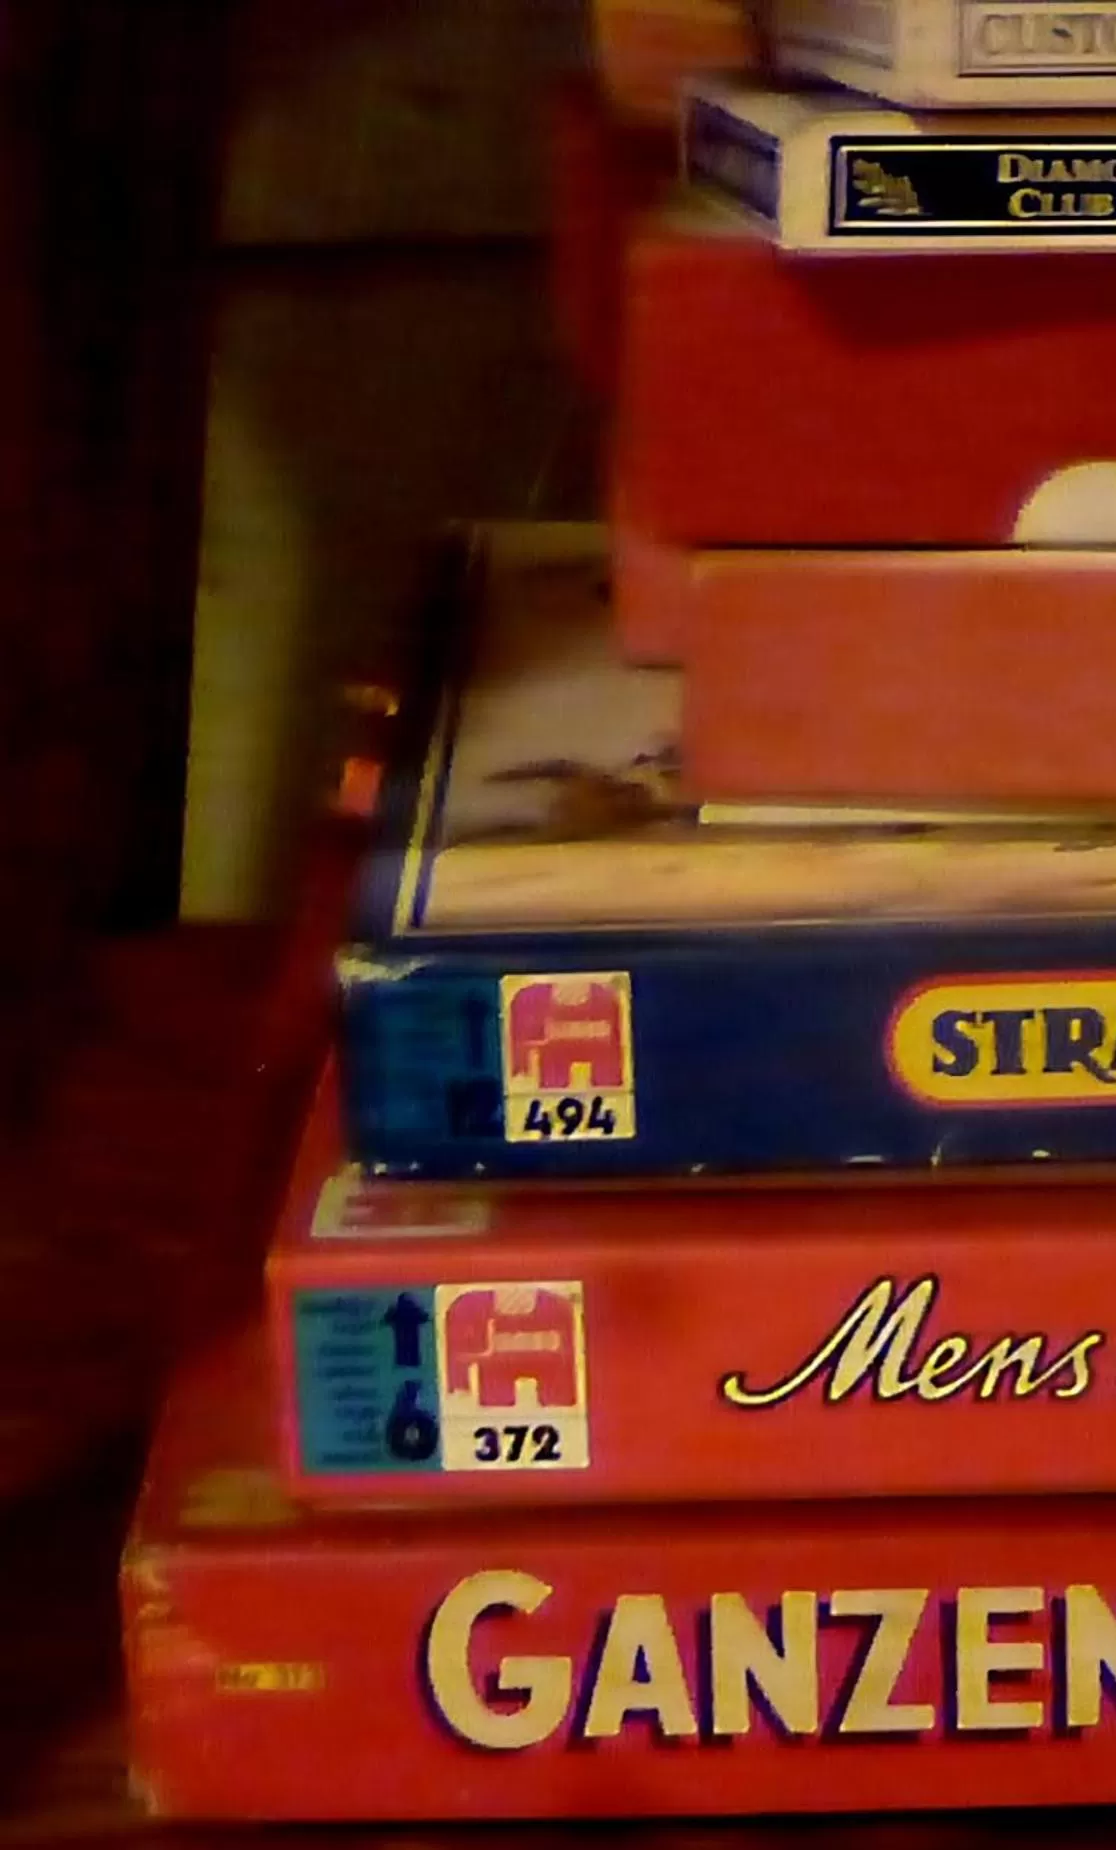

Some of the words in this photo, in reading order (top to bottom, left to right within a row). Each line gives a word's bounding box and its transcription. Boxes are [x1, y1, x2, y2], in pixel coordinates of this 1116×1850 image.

[1008, 188, 1115, 218] CLUB
[523, 1096, 616, 1136] 494
[723, 1278, 1101, 1405] Mens
[473, 1424, 562, 1462] 372
